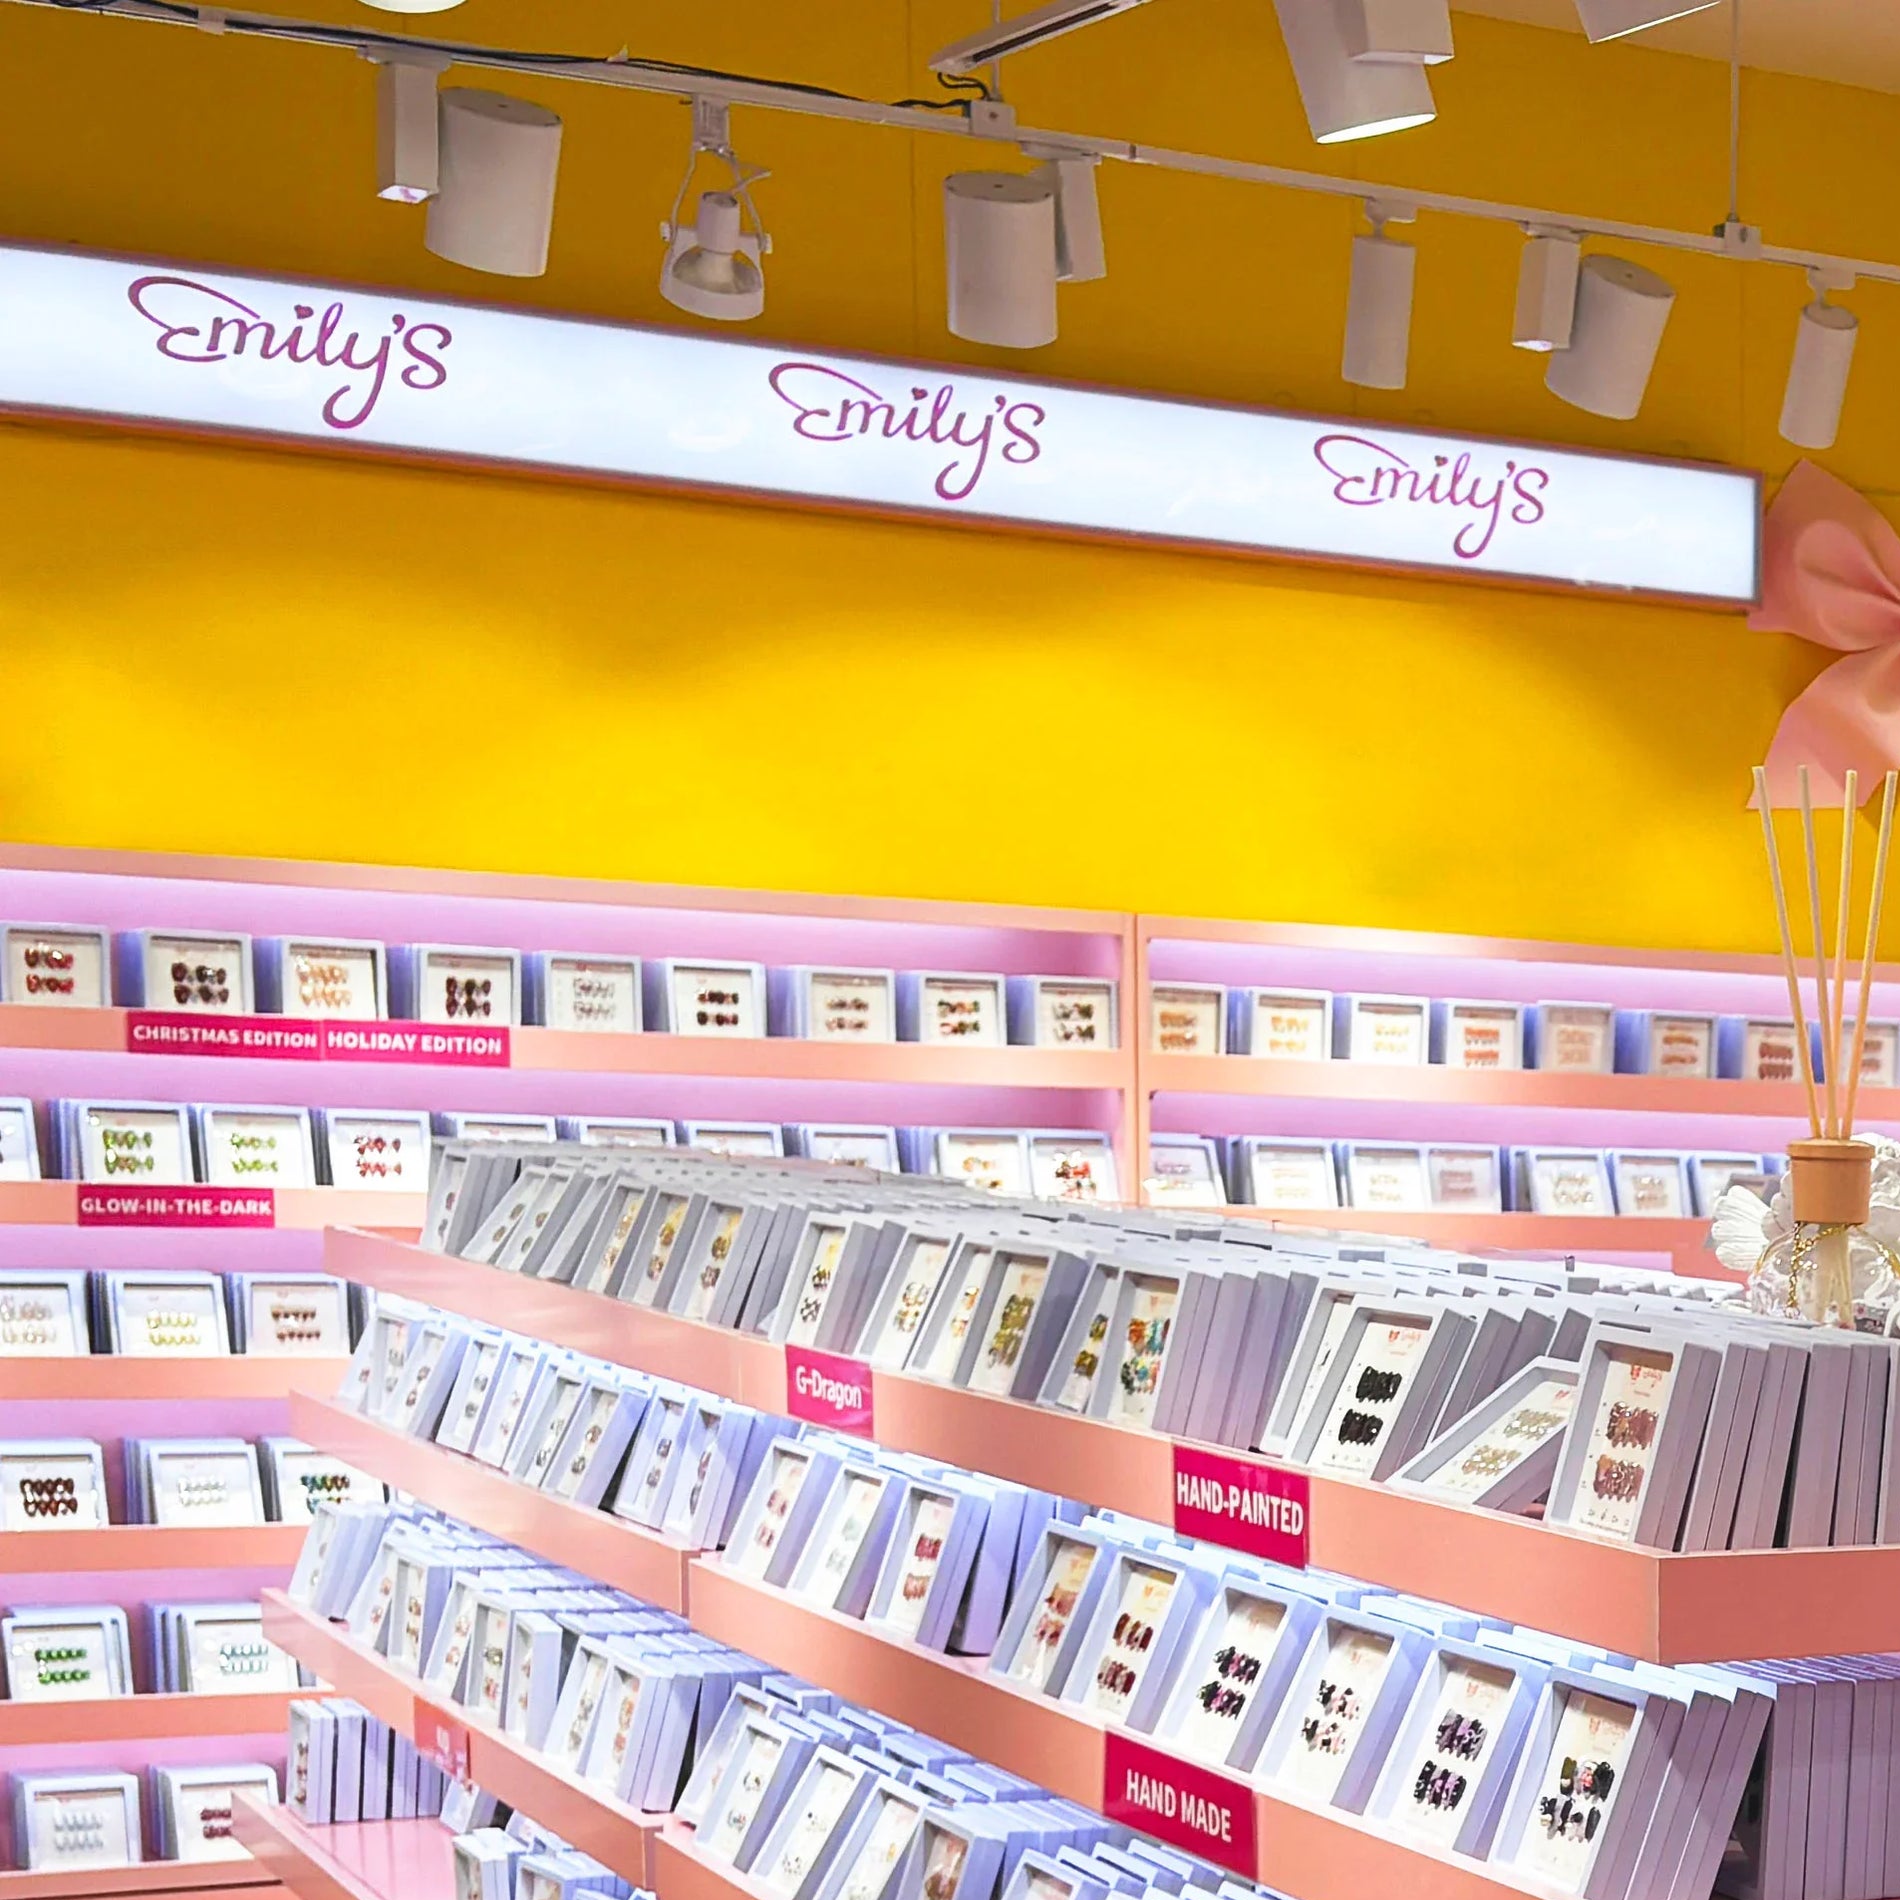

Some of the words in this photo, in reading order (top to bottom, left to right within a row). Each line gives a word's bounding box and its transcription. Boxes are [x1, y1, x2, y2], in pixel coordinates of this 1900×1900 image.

[133, 1025, 240, 1043] CHRISTMAS
[243, 1030, 318, 1047] EDITION
[327, 1030, 418, 1053] HOLIDAY
[421, 1034, 502, 1056] EDITION
[81, 1198, 273, 1216] GLOW-IN-THE-DARK
[795, 1364, 862, 1410] G-Dragon
[1176, 1471, 1304, 1536] HAND-PAINTED
[1127, 1769, 1178, 1819] HAND
[1181, 1791, 1233, 1843] MADE
